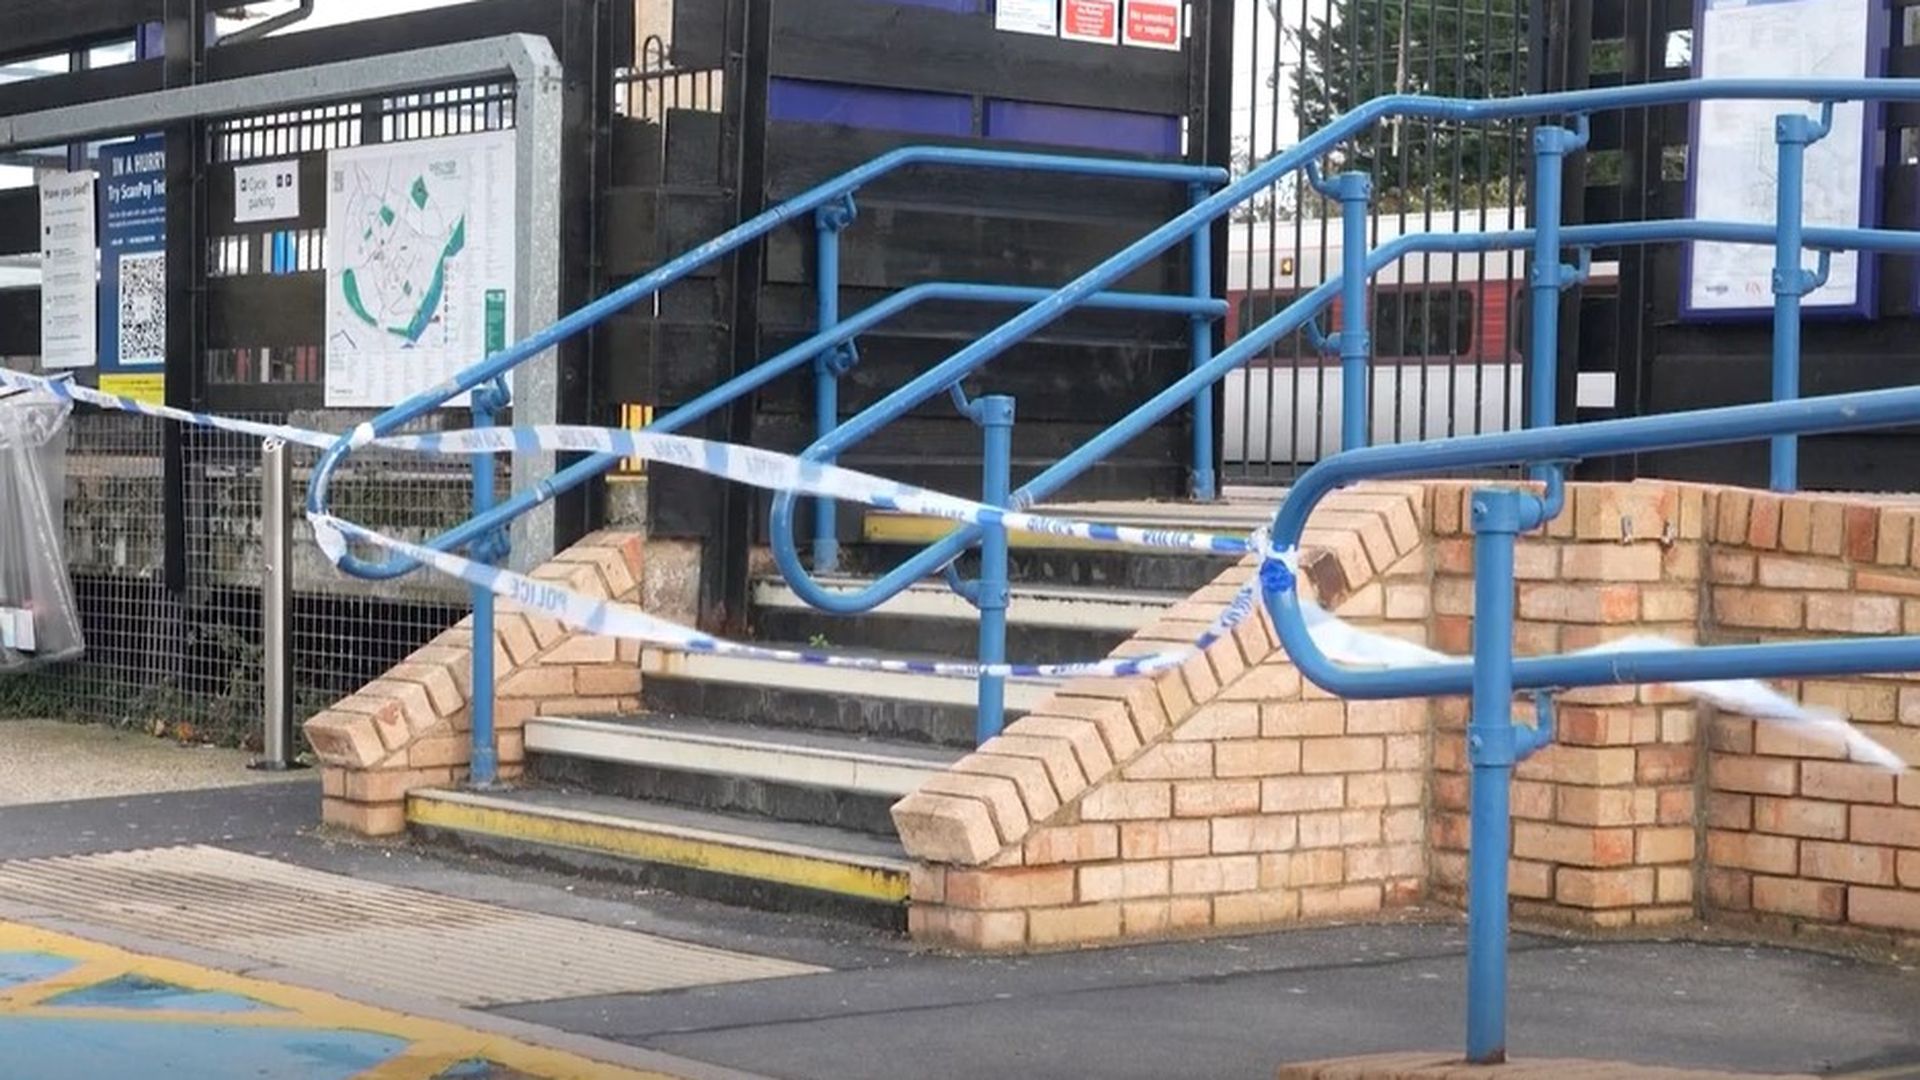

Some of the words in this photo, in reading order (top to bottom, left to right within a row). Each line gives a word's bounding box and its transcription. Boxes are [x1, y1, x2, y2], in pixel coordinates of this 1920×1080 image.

[1142, 13, 1174, 27] smoking
[112, 156, 124, 176] IN
[125, 154, 134, 175] A
[107, 185, 120, 204] Try
[121, 180, 152, 200] ScanPay
[249, 176, 268, 194] Cycle
[249, 197, 275, 211] parking
